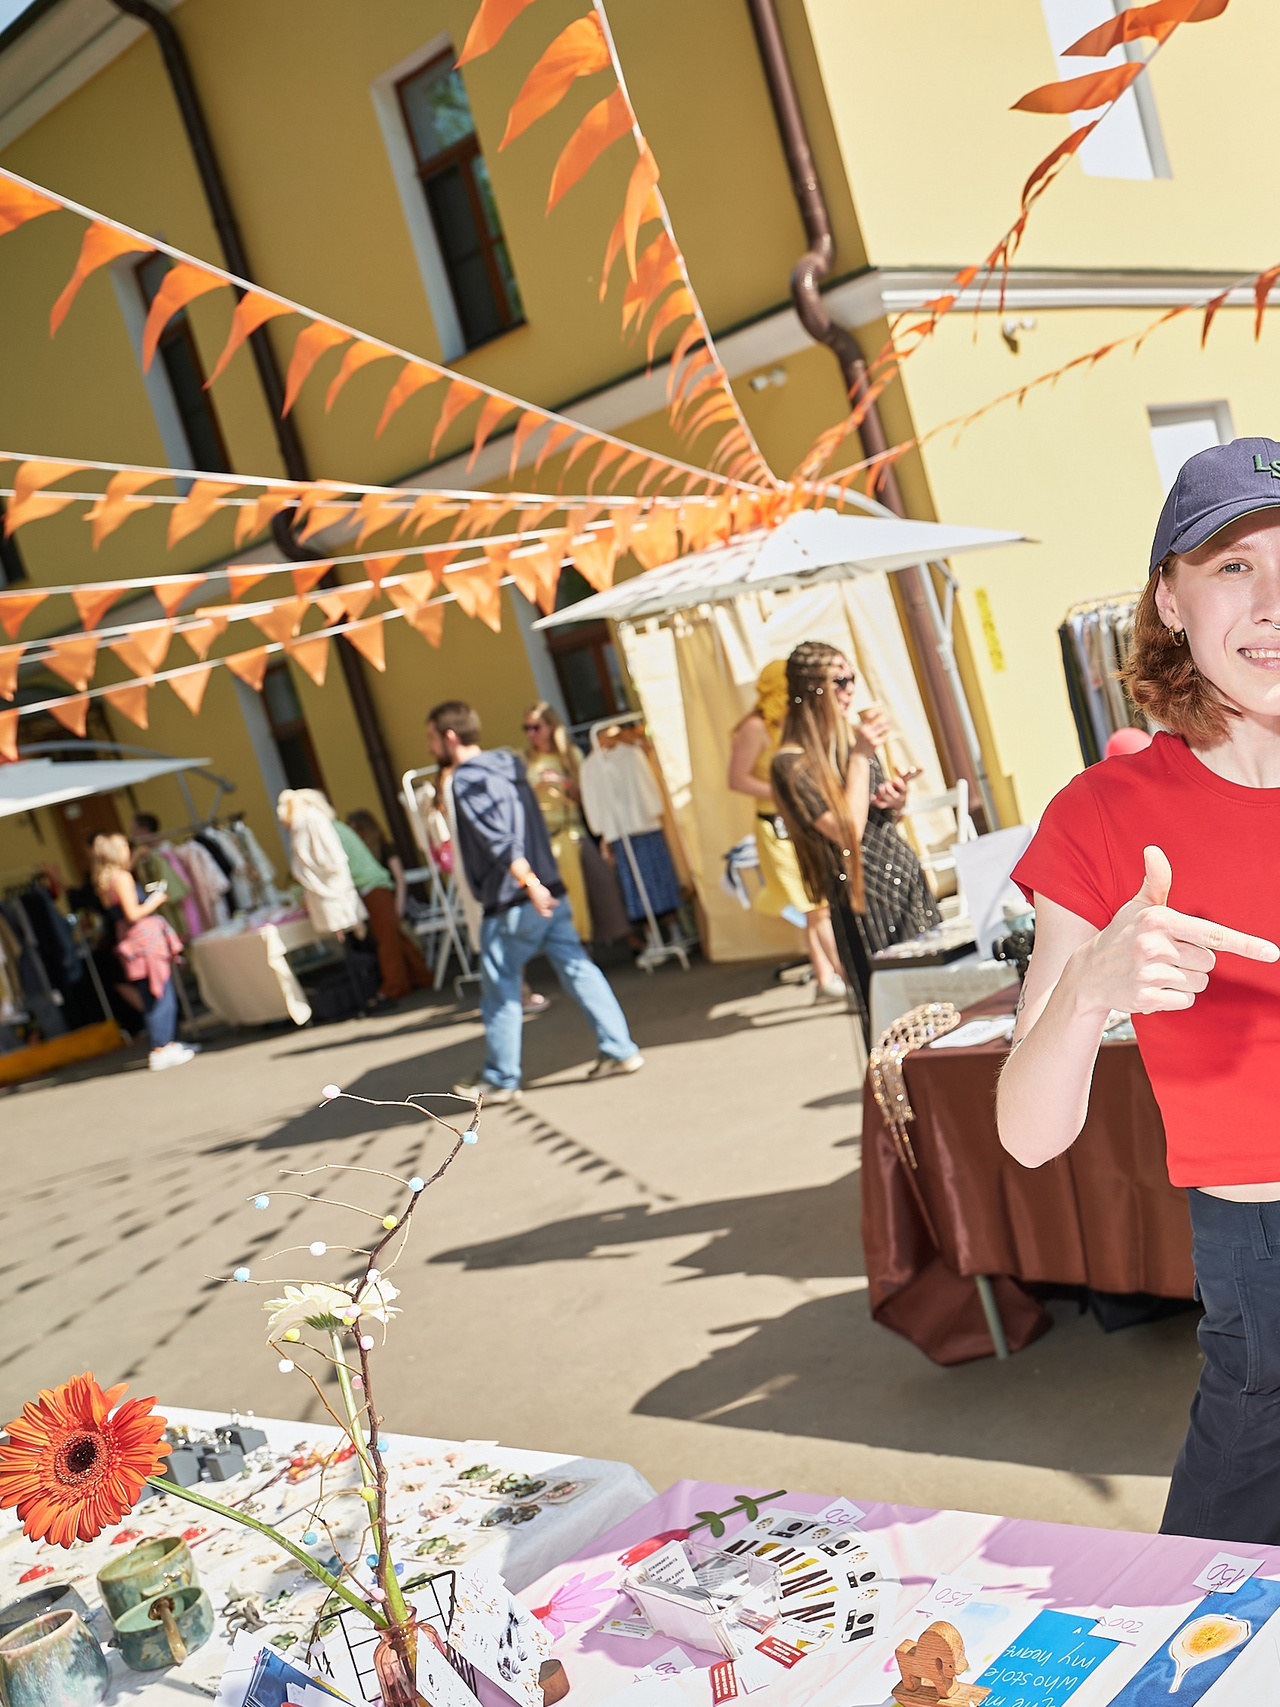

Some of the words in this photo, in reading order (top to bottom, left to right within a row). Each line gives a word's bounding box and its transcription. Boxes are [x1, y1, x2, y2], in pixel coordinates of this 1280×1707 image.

[825, 1508, 858, 1527] 150
[1206, 1563, 1246, 1588] 150
[935, 1587, 973, 1607] 250
[1108, 1618, 1144, 1634] 200
[1003, 1645, 1053, 1667] heart
[1057, 1641, 1096, 1669] my
[984, 1667, 1032, 1686] stole
[1033, 1676, 1079, 1694] who
